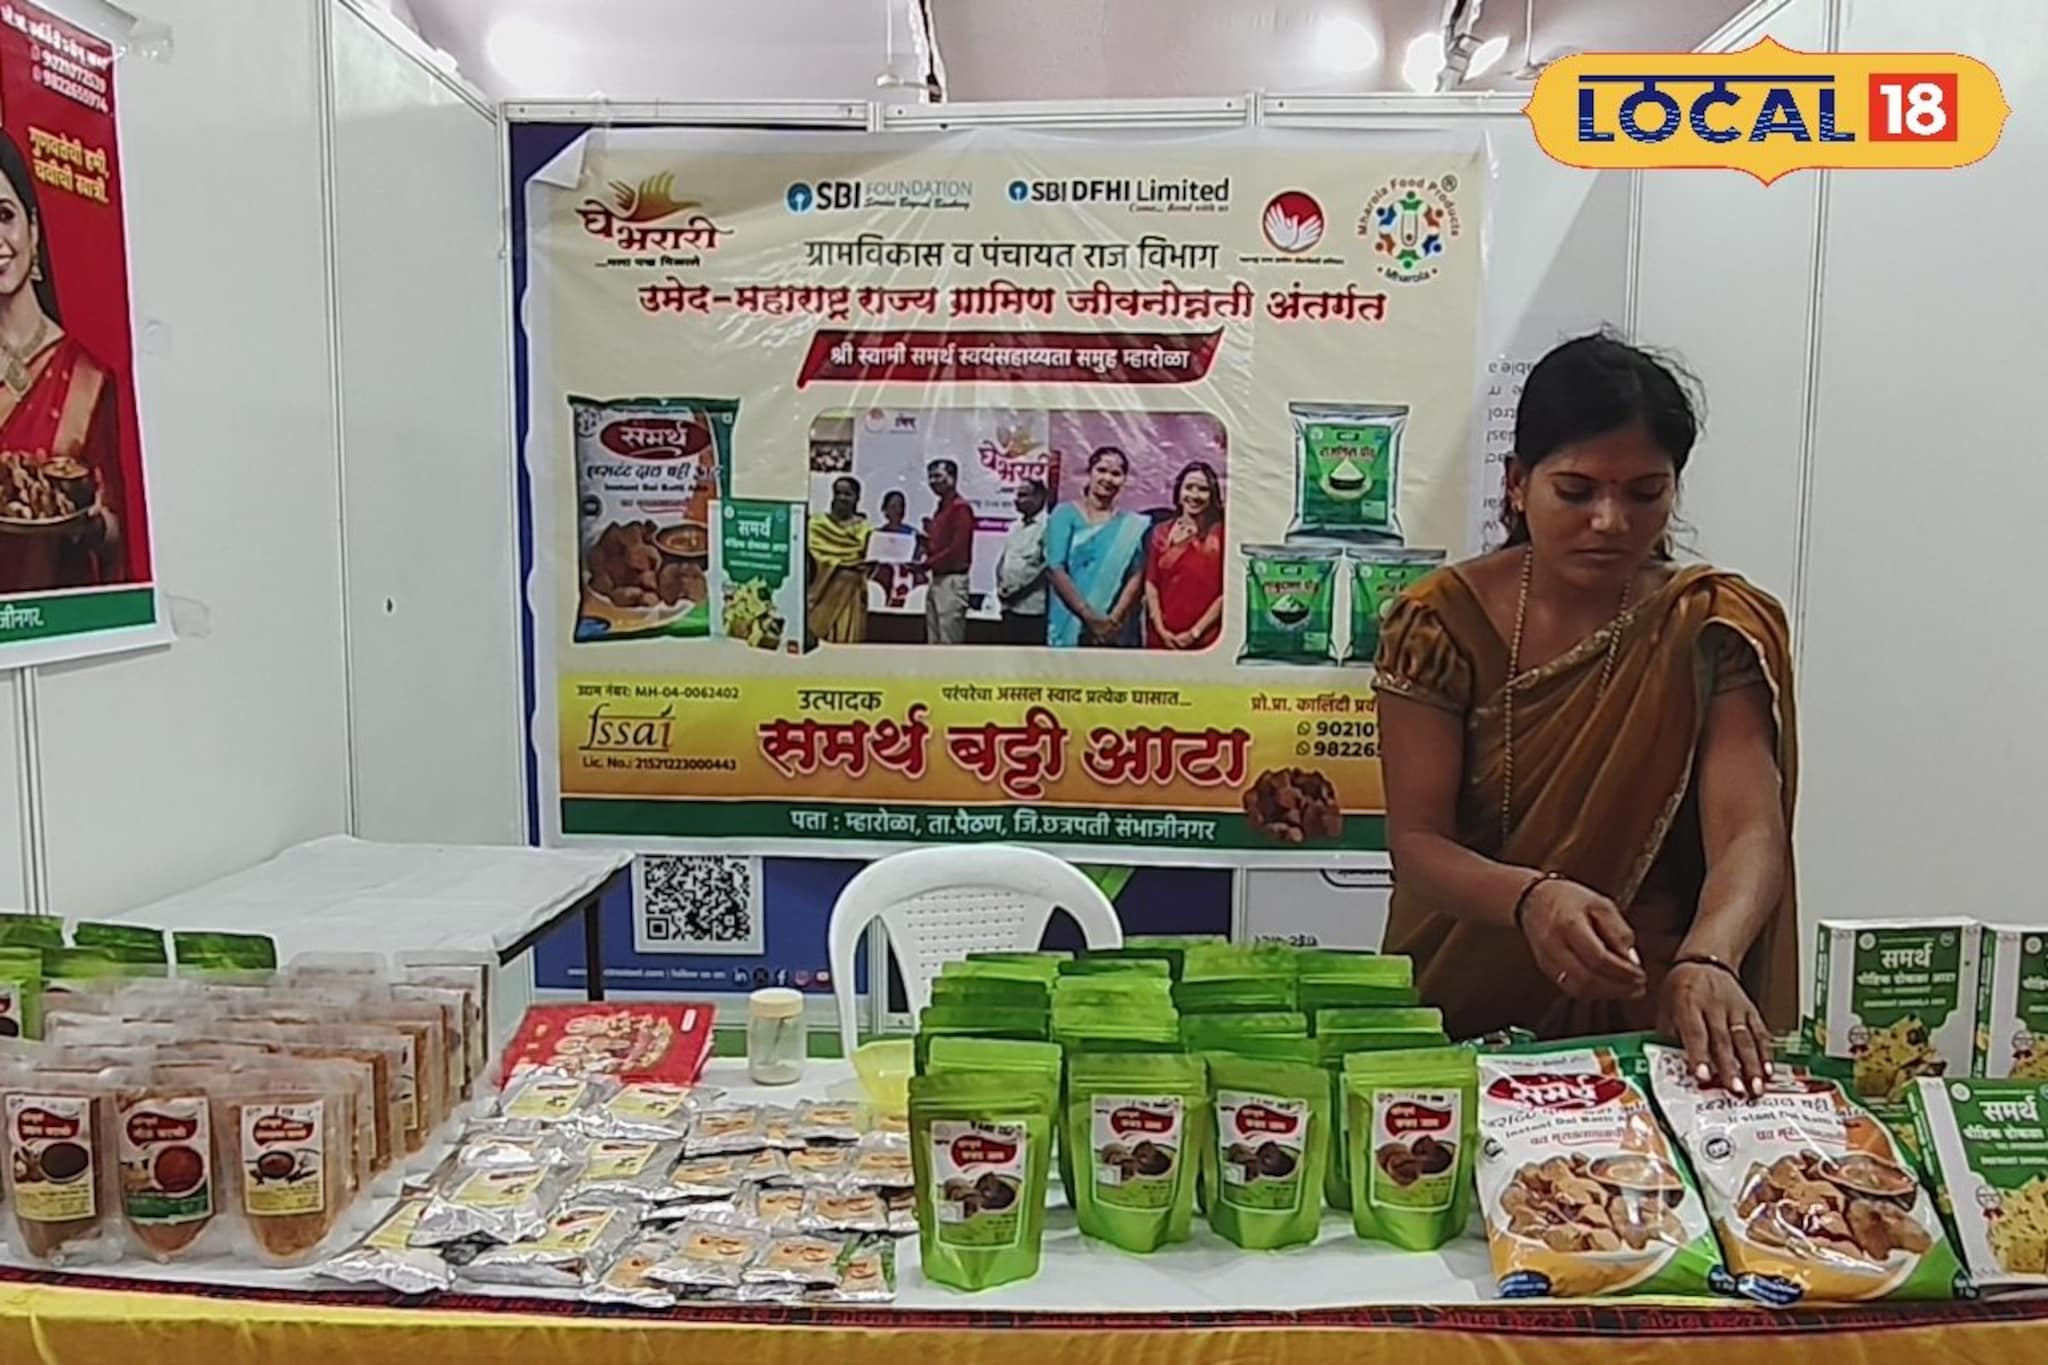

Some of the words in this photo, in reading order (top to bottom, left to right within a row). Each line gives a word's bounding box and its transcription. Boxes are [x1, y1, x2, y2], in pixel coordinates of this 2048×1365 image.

[816, 181, 861, 209] SBI
[866, 180, 973, 197] FOUNDATION
[1032, 181, 1067, 201] SBI
[1072, 181, 1130, 201] DFHI
[1138, 178, 1229, 201] Limited
[1390, 178, 1425, 190] Food
[616, 216, 735, 250] भरारी
[804, 233, 945, 267] ग्रामविकास
[951, 243, 974, 267] व
[981, 236, 1076, 268] पंचायत
[1082, 243, 1131, 268] राज
[1137, 235, 1220, 269] विभाग
[858, 286, 938, 317] राज्य
[949, 279, 1056, 318] ग्रामिण
[1066, 279, 1255, 320] जीवनोन्नती
[1266, 282, 1387, 321] अंतर्गत
[830, 341, 853, 365] श्री
[857, 341, 906, 365] स्वामी
[910, 342, 957, 366] समर्थ
[1074, 348, 1119, 373] समुह
[1121, 343, 1190, 369] म्हारोळा
[619, 422, 688, 448] समर्थ
[797, 688, 884, 713] उत्पादक
[942, 683, 993, 702] परंपरेचा
[996, 686, 1043, 702] अस्सल
[1047, 687, 1083, 703] स्वाद
[1086, 686, 1129, 705] प्रत्येक
[1296, 691, 1351, 713] कालिंदी
[1316, 721, 1377, 738] 90210
[759, 704, 932, 779] समर्थ
[945, 705, 1070, 799] बट्टी
[1083, 723, 1252, 787] आटा
[1314, 741, 1380, 758] 98226
[1114, 813, 1217, 840] संभाजीनगर
[1880, 943, 1934, 968] समर्थ
[1979, 1095, 2039, 1122] समर्थ
